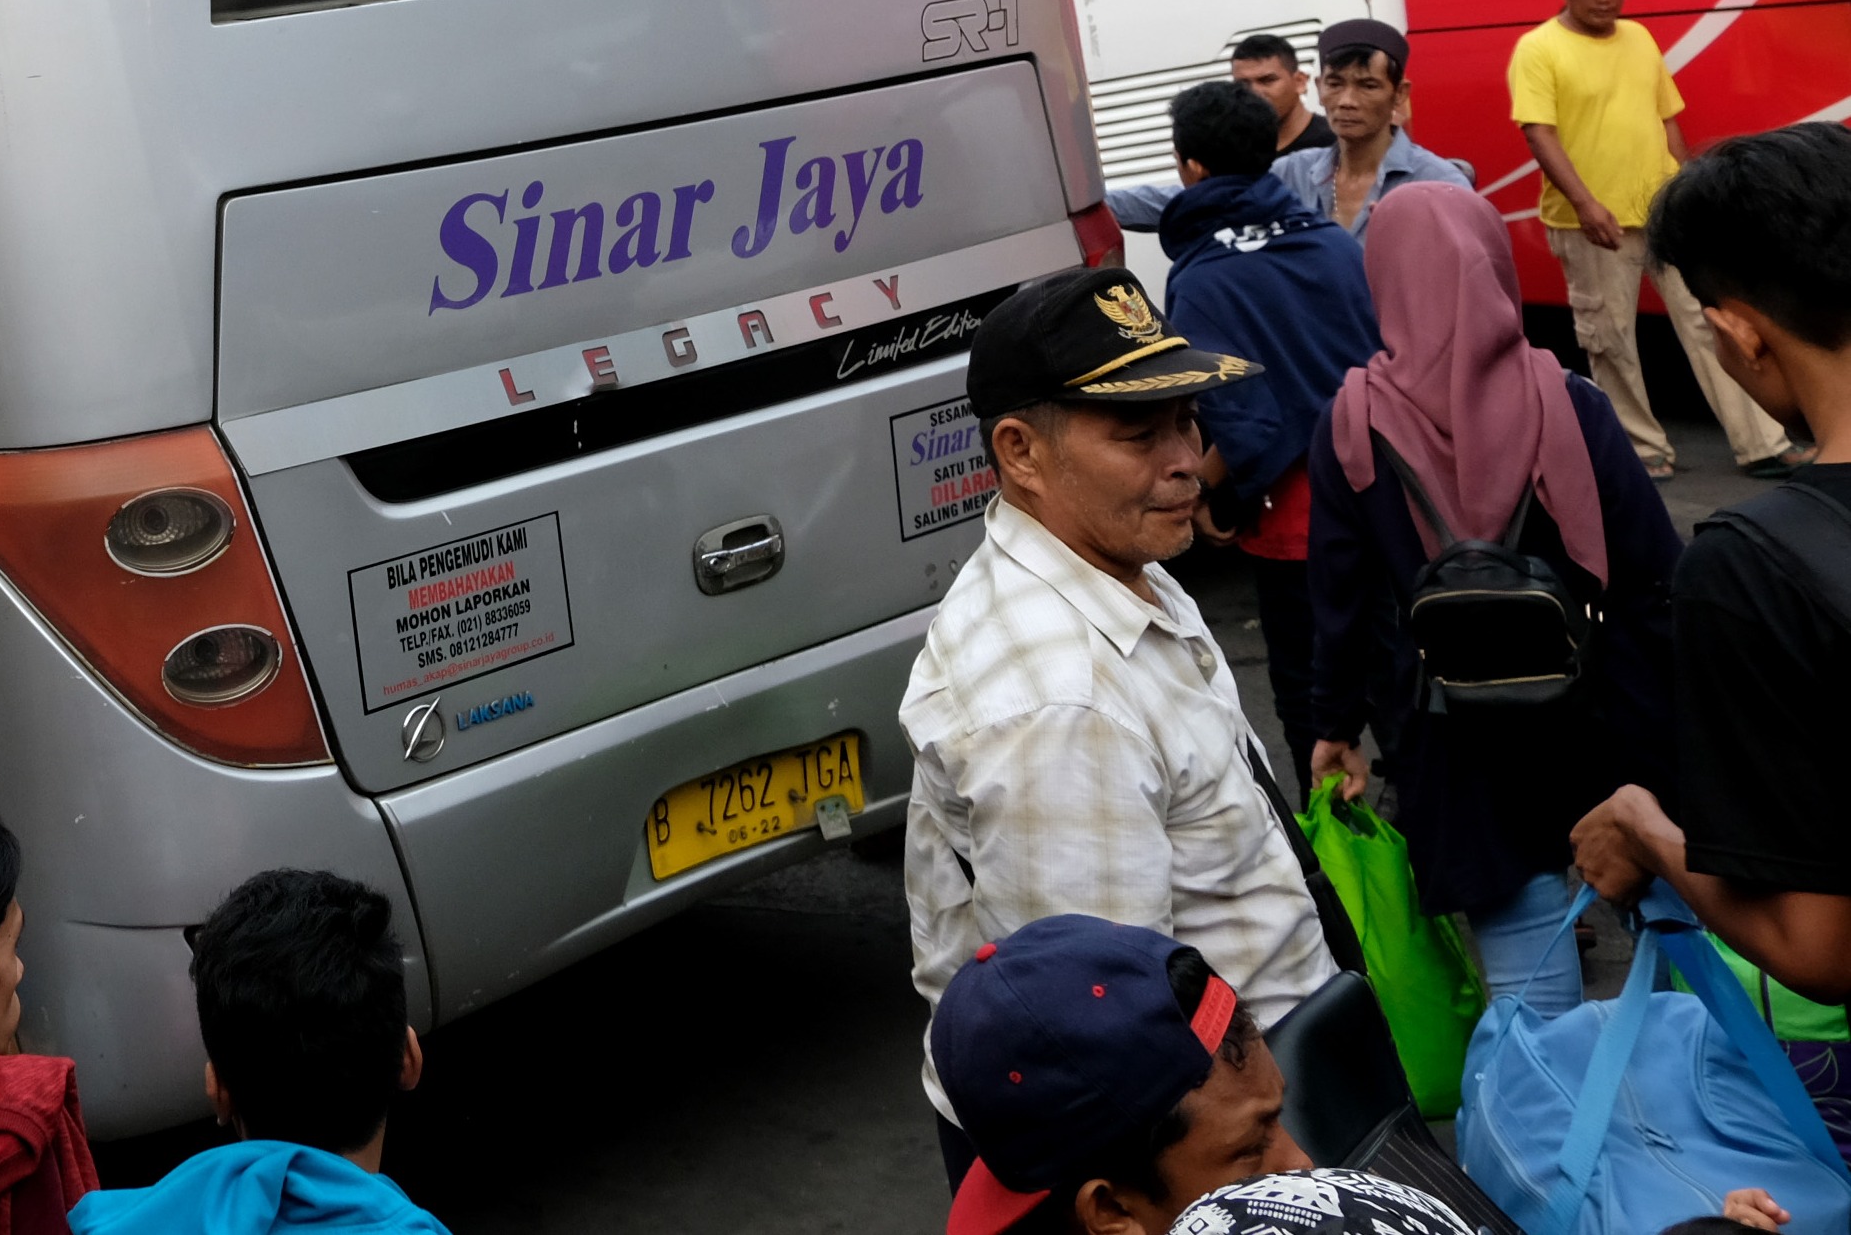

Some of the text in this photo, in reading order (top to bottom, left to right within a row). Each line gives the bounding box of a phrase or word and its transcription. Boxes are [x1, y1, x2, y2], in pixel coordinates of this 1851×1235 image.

[428, 135, 926, 316] Sinar Jaya
[497, 274, 903, 406] LEGACY
[837, 326, 920, 380] Limited
[930, 401, 974, 428] SESAM
[910, 424, 977, 467] Sinar
[930, 468, 998, 508] DILARA
[934, 461, 965, 484] SATU
[914, 502, 959, 530] SALING
[386, 527, 528, 590] BILA PENGEMUDI KAMI
[396, 579, 531, 634] MOHON LAPORKAN
[407, 560, 516, 610] MEMBAHAYAKAN
[400, 599, 532, 653] TELP./FAX. (021) 88336059
[417, 622, 520, 669] SMS. 08121284777
[382, 633, 556, 696] humas_akap@sinarjayagroup.co.id
[456, 690, 535, 732] LAKSANA
[653, 740, 854, 845] B 7262 TGA
